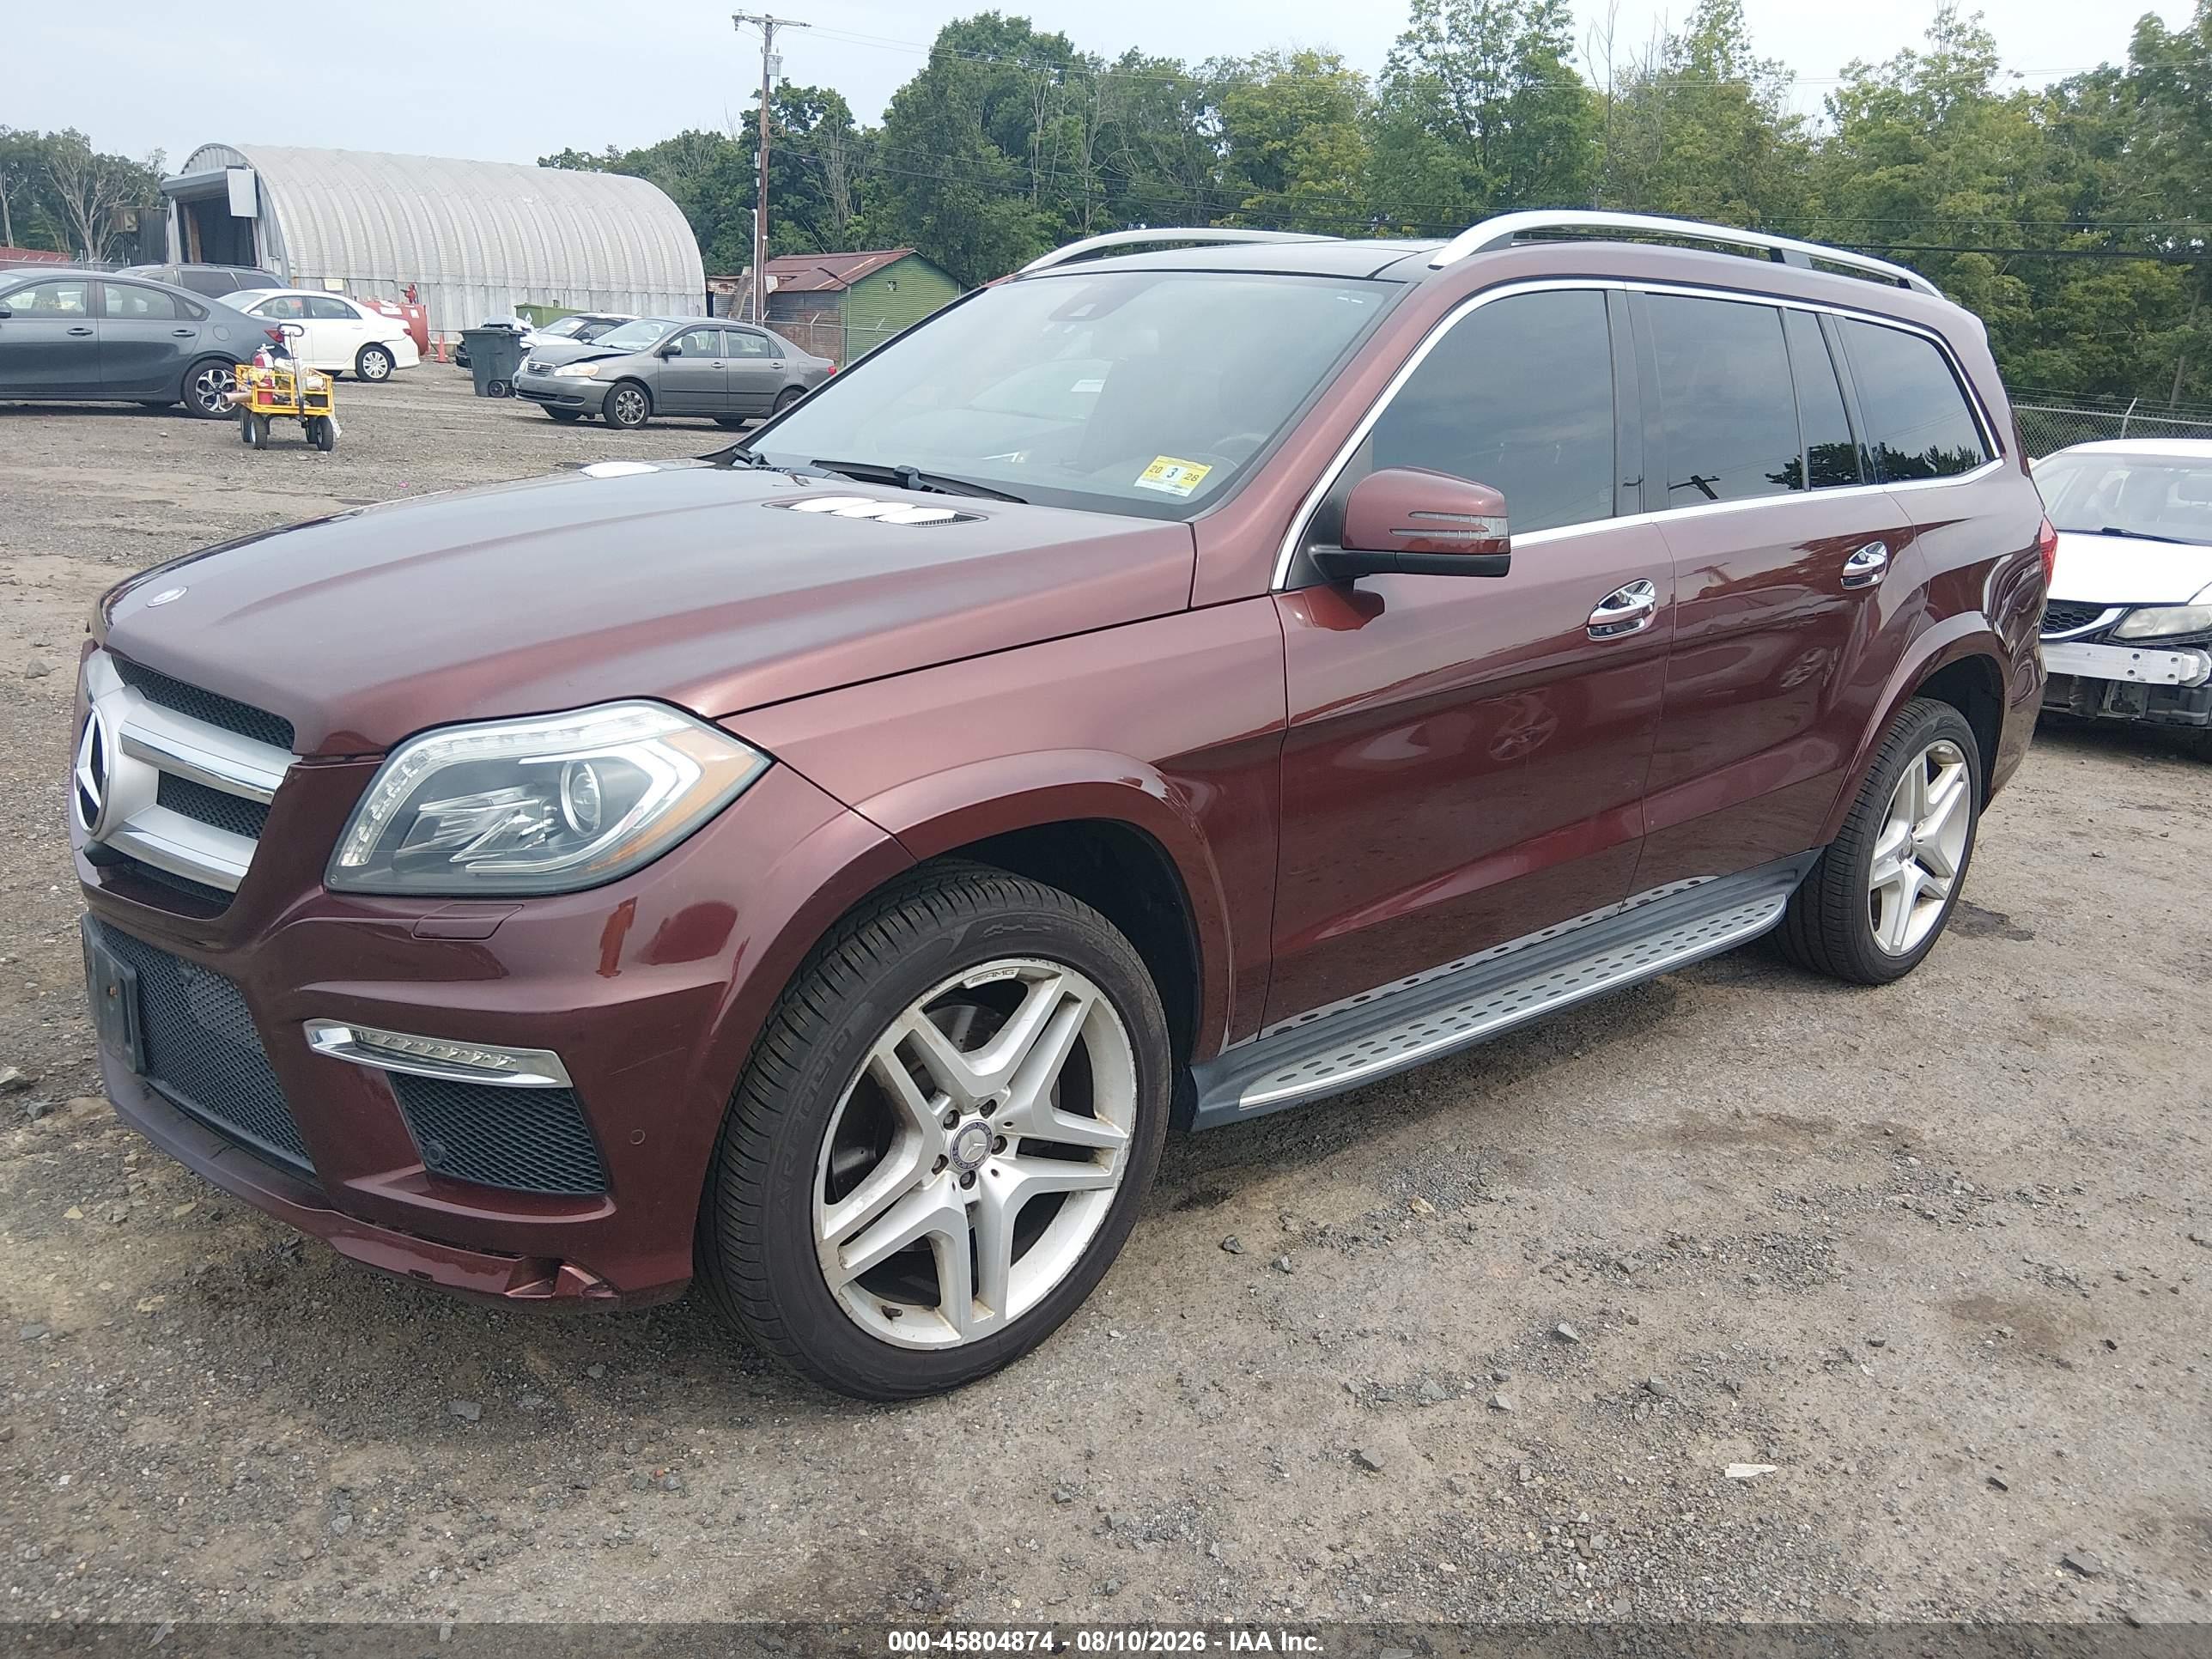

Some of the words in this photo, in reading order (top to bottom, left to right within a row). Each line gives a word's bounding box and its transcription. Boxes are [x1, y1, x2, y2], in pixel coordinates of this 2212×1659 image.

[1149, 465, 1164, 474] 20
[1166, 467, 1179, 478] 3
[1183, 472, 1200, 482] 28
